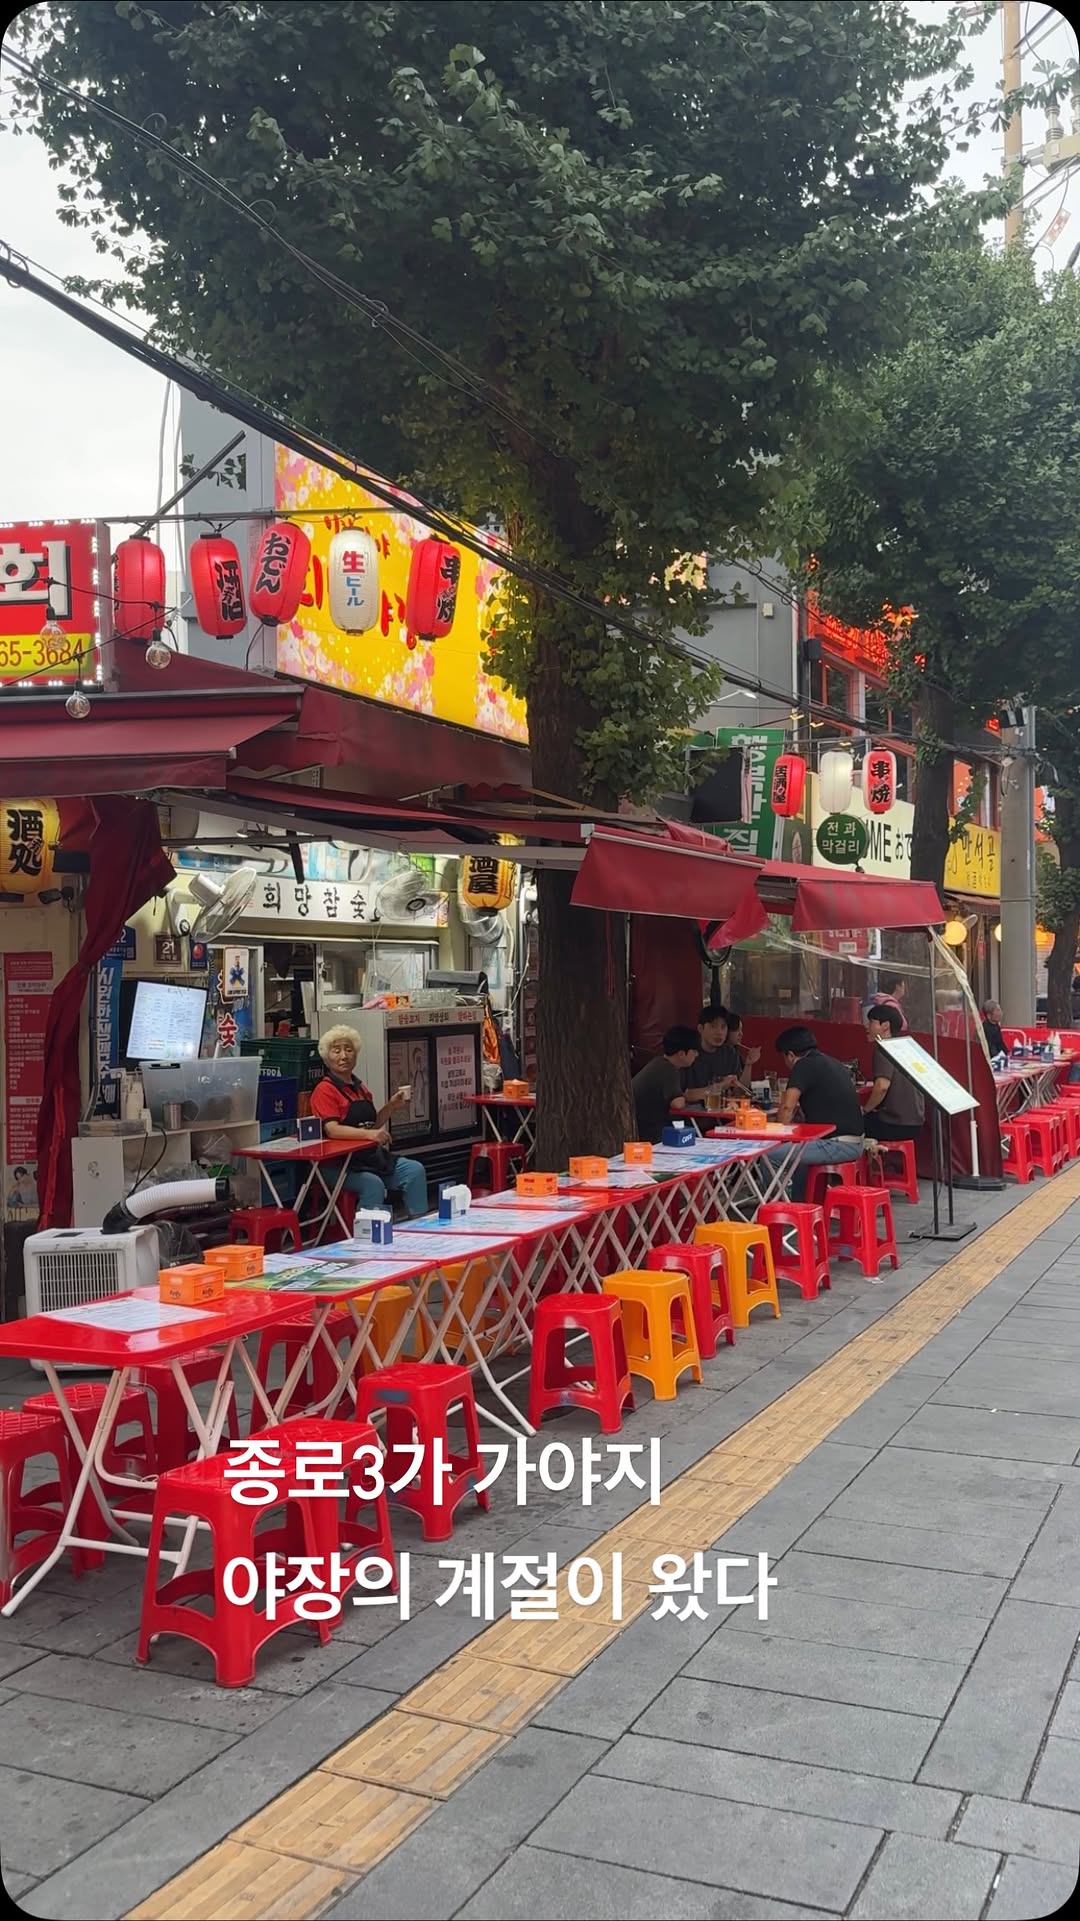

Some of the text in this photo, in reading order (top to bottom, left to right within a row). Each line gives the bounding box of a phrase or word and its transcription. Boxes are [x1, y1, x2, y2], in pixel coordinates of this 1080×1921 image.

[255, 532, 292, 595] おでん
[341, 550, 366, 608] 生ビール
[821, 838, 860, 855] 막걸리
[162, 941, 176, 955] 21
